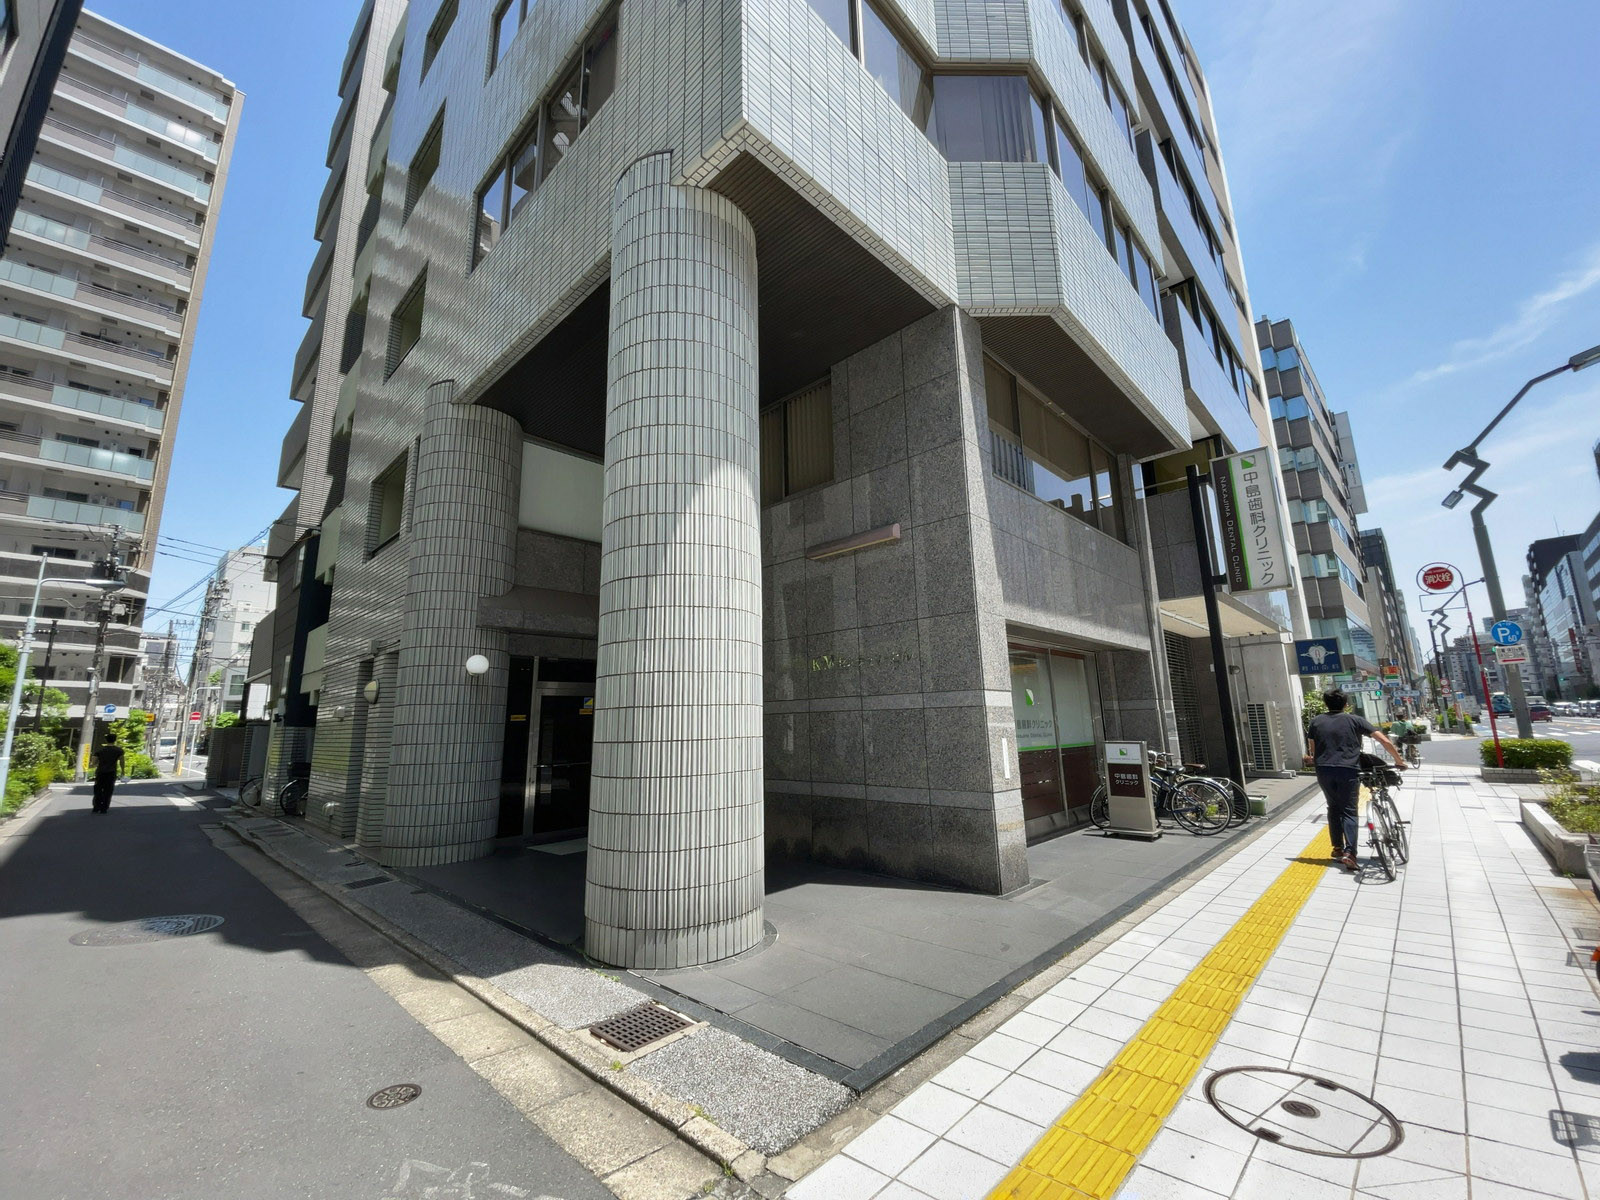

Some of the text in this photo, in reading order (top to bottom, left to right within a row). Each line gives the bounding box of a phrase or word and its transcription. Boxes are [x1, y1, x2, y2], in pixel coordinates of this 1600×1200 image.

[1220, 476, 1242, 583] NAKAJIMA DENTAL CLINIC
[1243, 471, 1275, 586] 中島歯科クリニック
[1424, 572, 1452, 585] 消火栓
[1497, 628, 1510, 642] P
